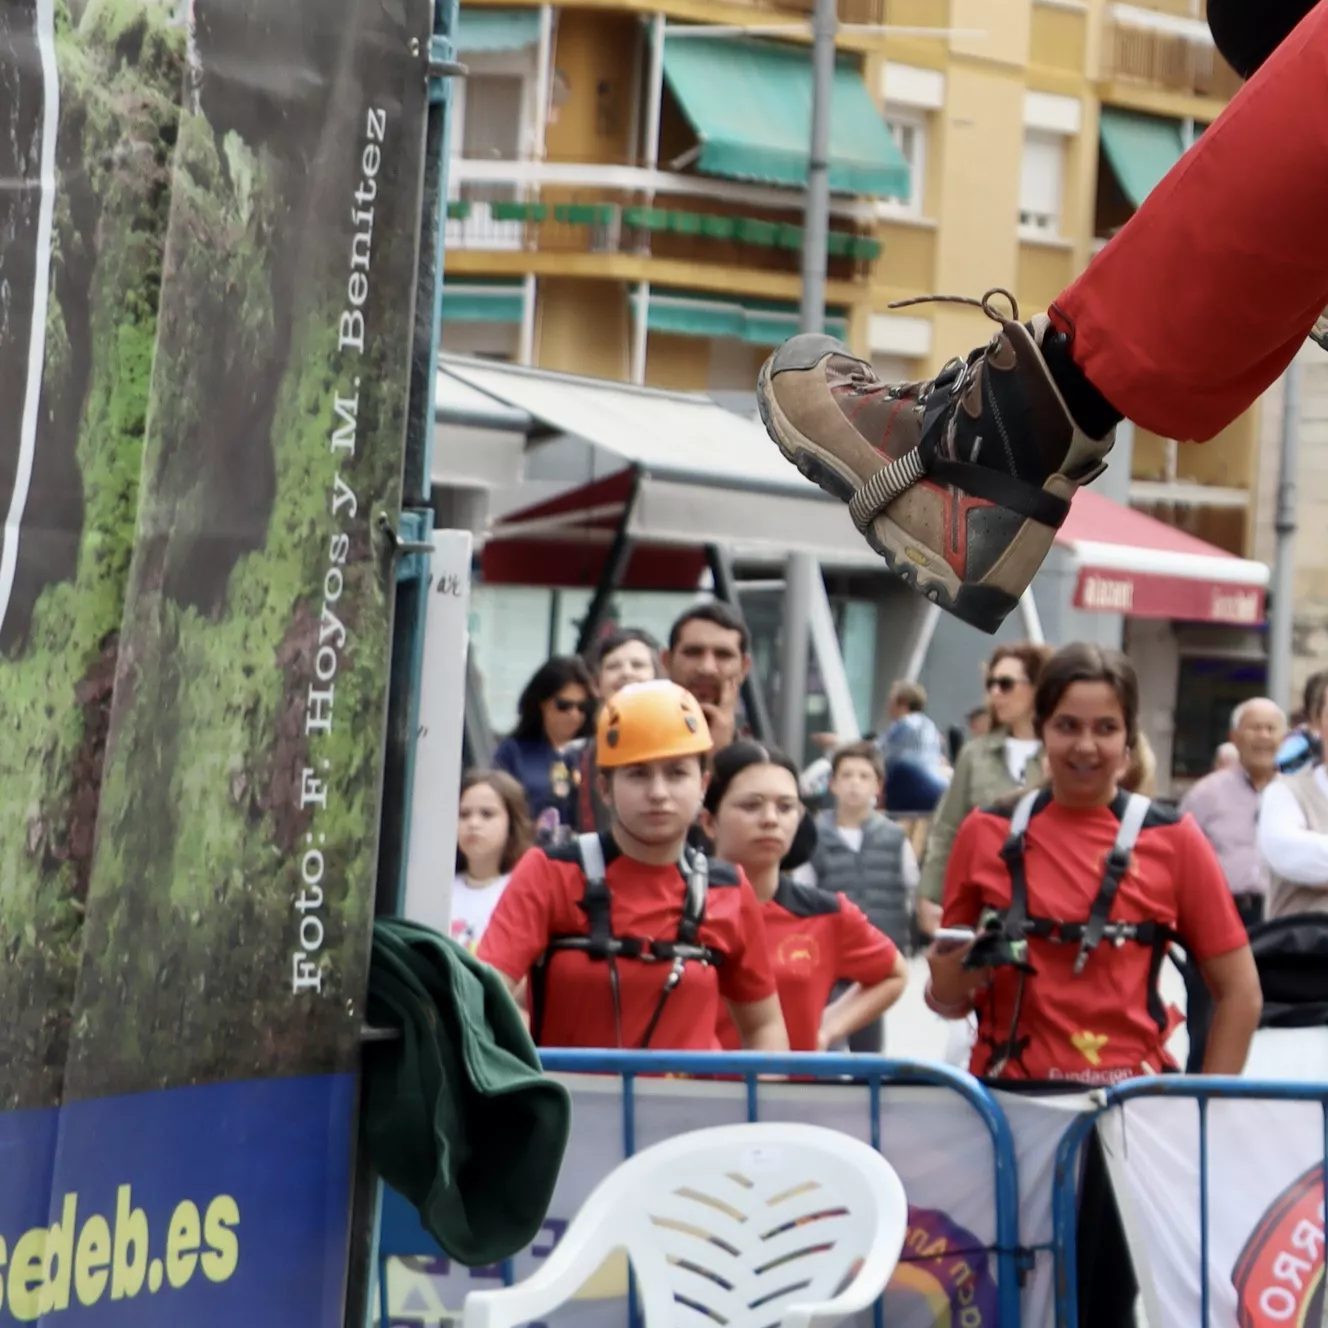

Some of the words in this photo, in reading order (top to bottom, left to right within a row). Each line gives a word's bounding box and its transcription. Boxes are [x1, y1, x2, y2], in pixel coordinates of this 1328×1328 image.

[338, 107, 387, 354] Benítez
[331, 376, 360, 456] M.
[332, 472, 358, 519] y
[306, 532, 349, 736] Hoyos
[301, 759, 329, 810] F.
[293, 831, 325, 994] Foto:
[0, 1183, 240, 1322] edeb.es
